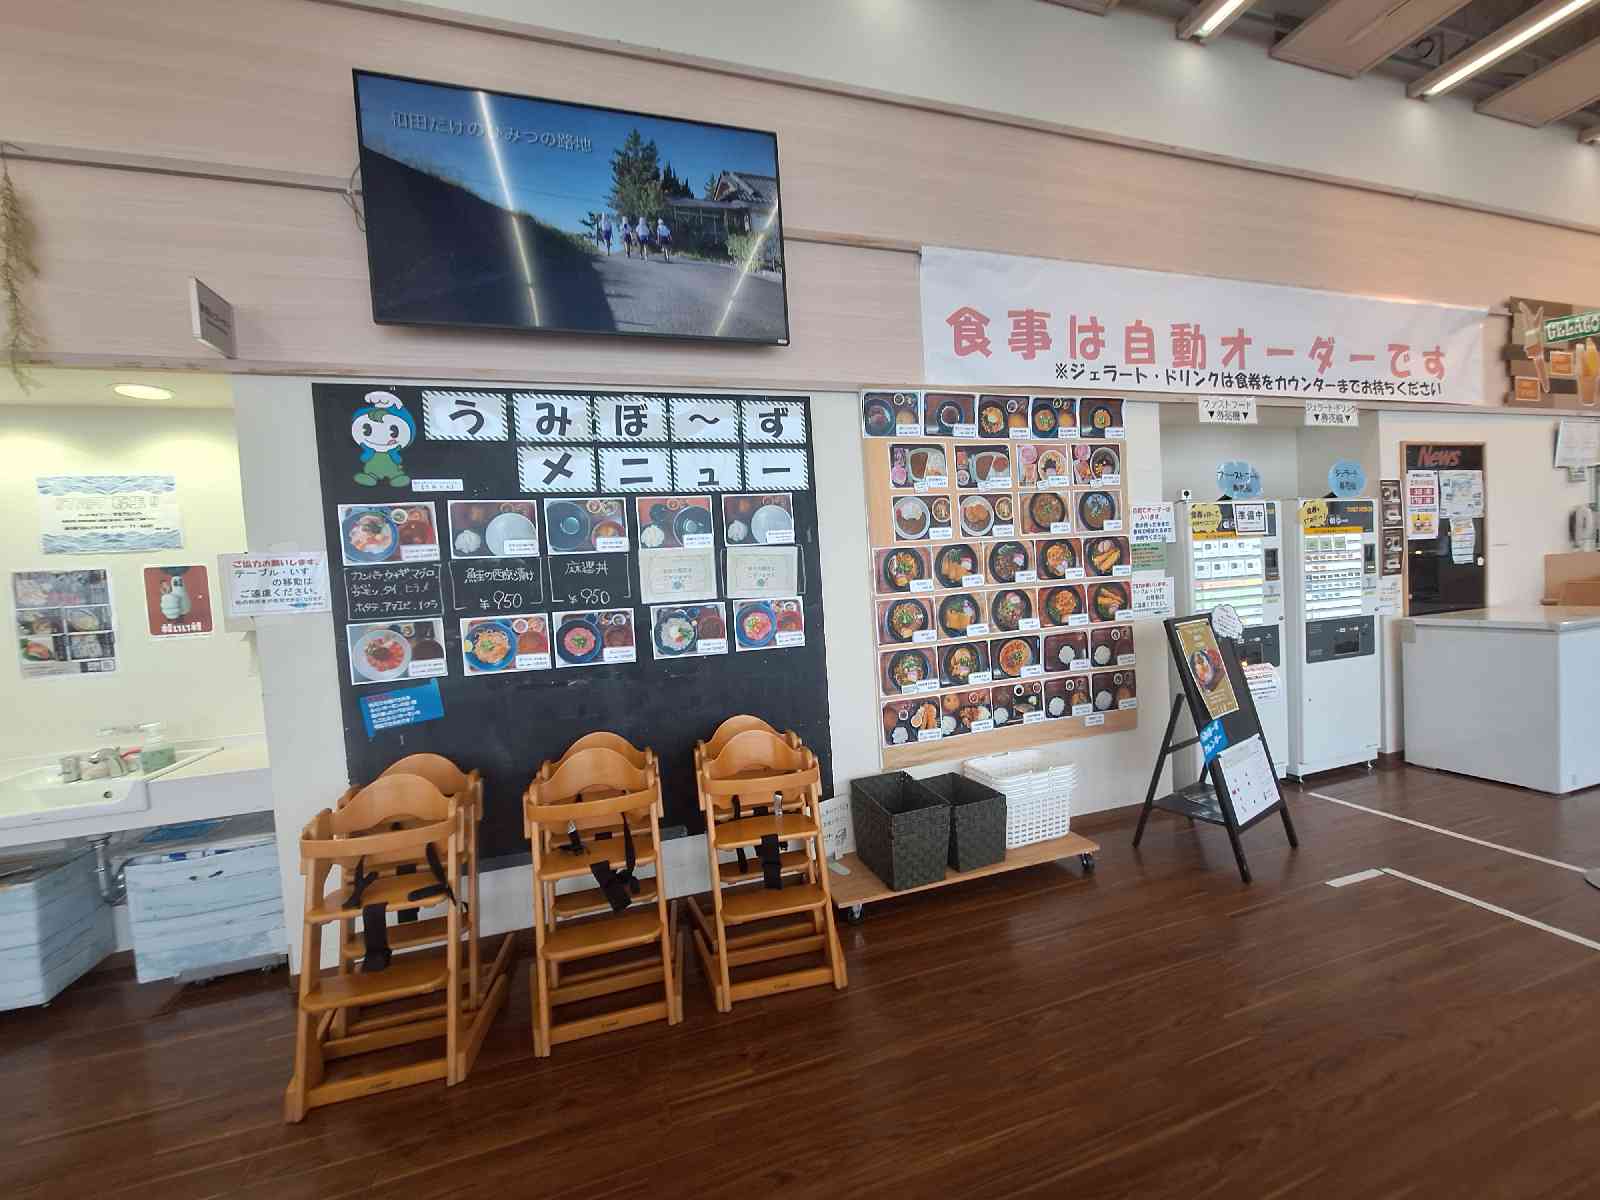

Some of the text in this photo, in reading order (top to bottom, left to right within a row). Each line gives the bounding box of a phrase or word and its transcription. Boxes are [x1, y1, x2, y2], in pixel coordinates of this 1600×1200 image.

[945, 306, 1447, 380] 食事は自動オーダーです
[542, 452, 791, 487] メニュー
[1418, 446, 1462, 467] News
